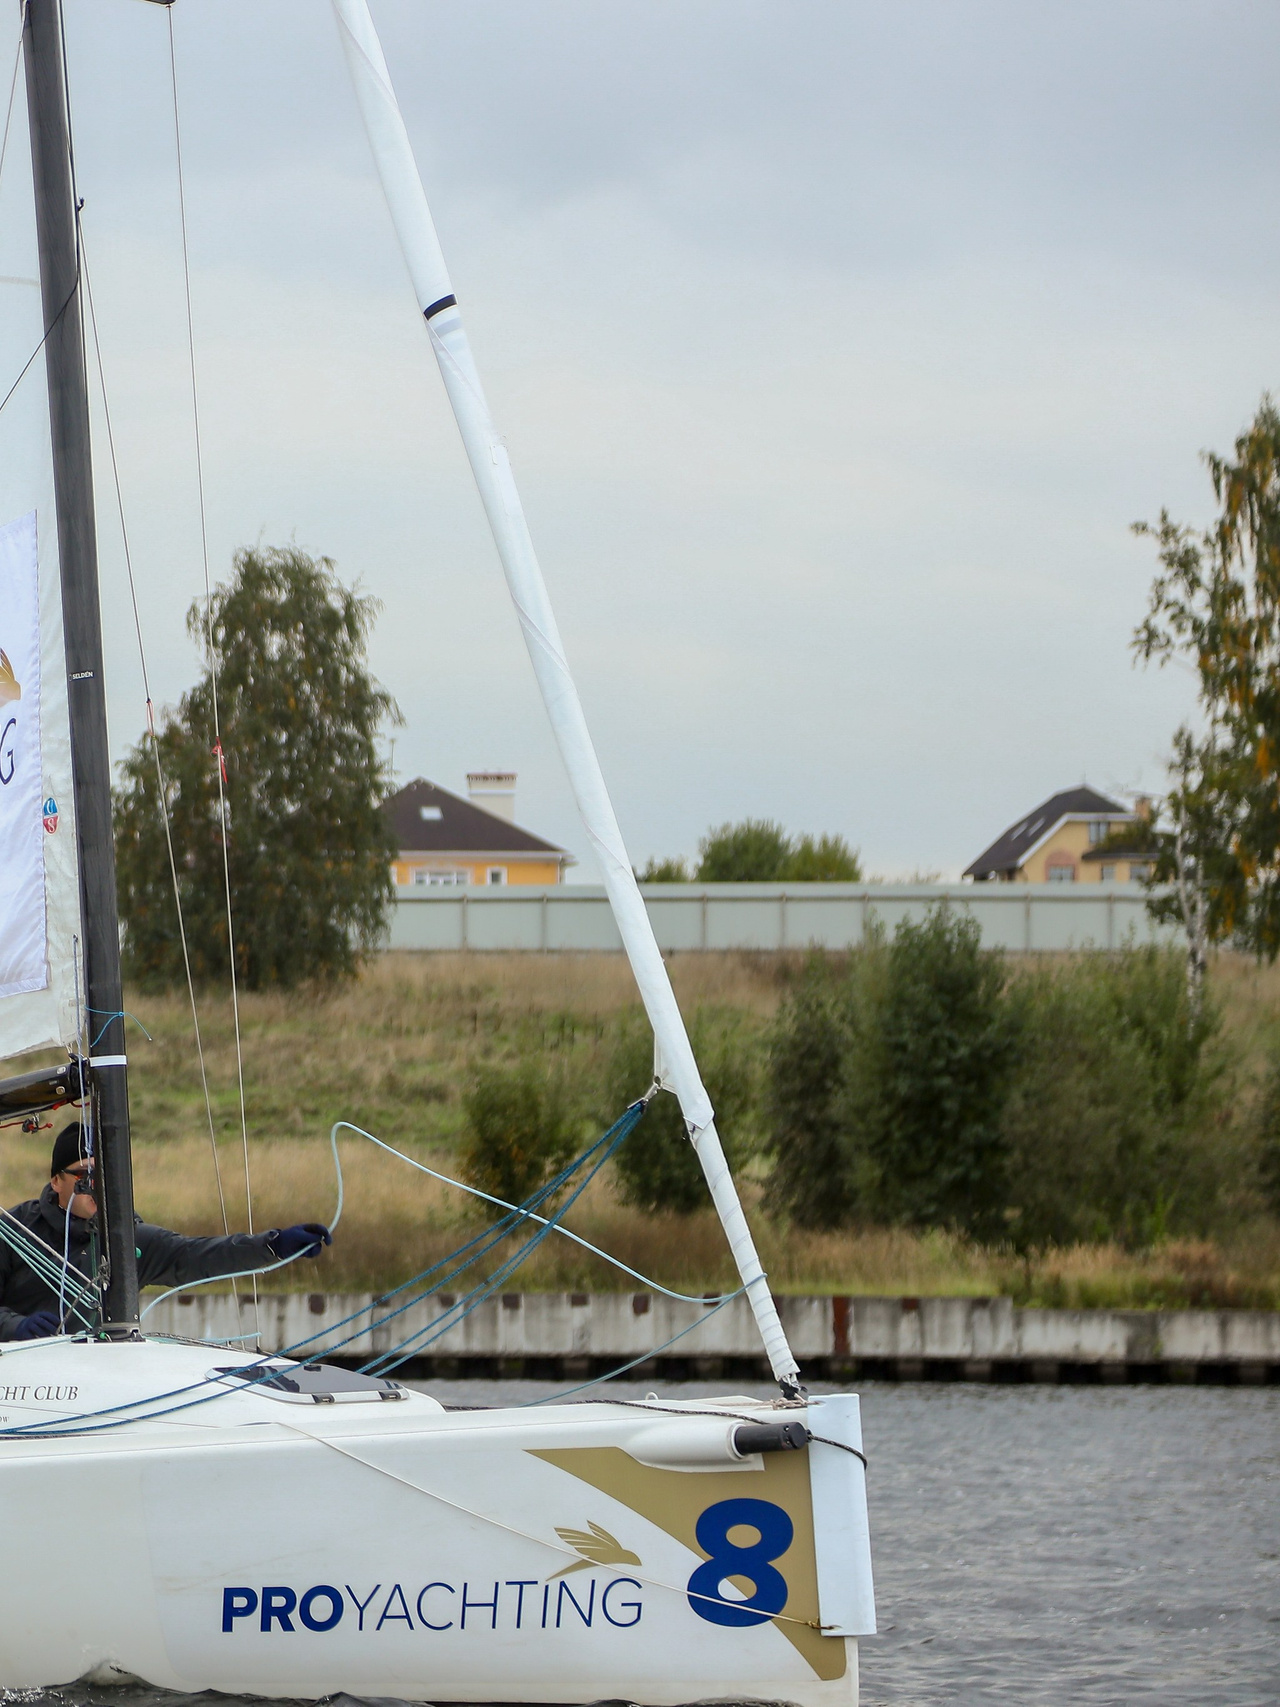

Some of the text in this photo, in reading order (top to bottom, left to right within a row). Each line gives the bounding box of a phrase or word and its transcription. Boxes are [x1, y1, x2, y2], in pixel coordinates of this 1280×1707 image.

[34, 1385, 79, 1401] CLUB
[687, 1497, 794, 1628] 8
[222, 1576, 644, 1633] PROYACHTING
